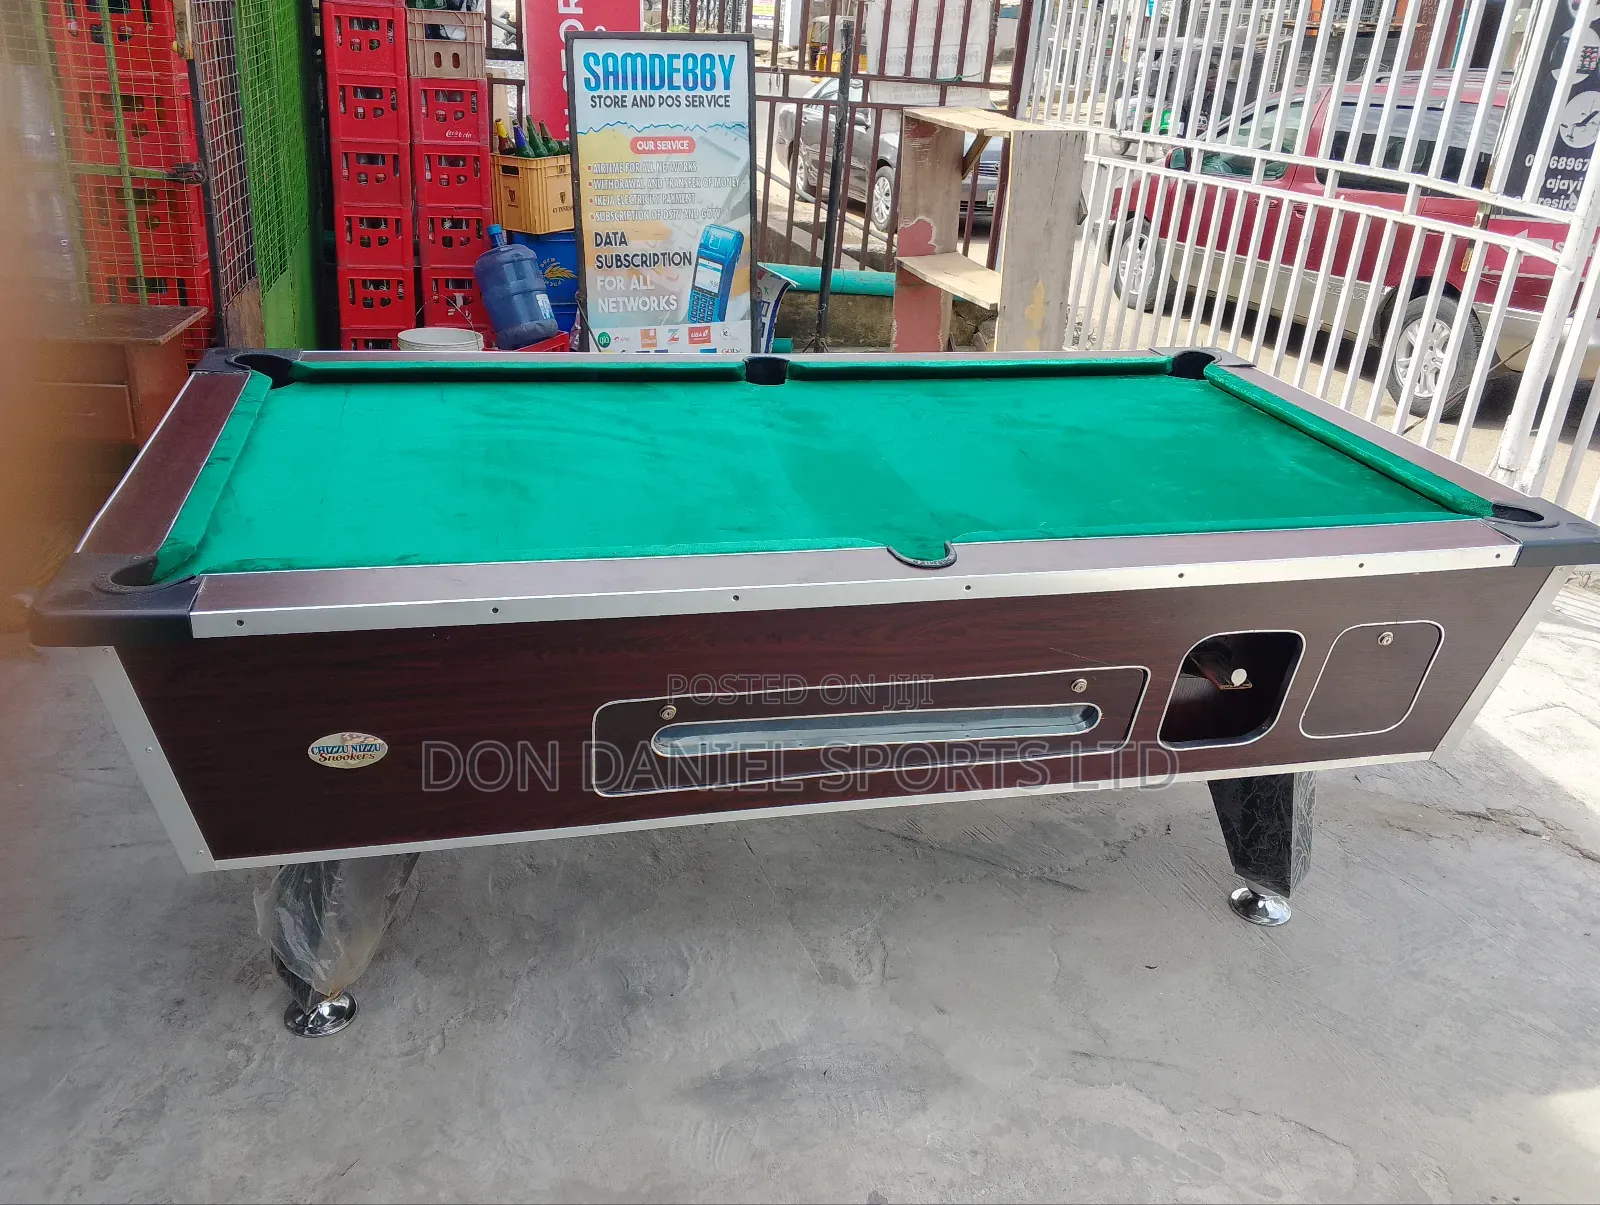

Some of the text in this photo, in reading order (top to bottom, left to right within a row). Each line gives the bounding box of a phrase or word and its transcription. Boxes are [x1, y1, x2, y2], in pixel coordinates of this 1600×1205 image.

[583, 52, 736, 91] SAMDEBBY
[590, 94, 731, 109] STORE AND POS SERVICE
[636, 140, 690, 151] OUR SERVICE
[593, 161, 698, 174] AIRTIME FOR ALL NETWORKS
[593, 176, 740, 190] WITHDRAWAL AND TRANSFER OF MONEY
[594, 193, 696, 206] IKEJA ELECTRICITY PAYMENT
[595, 210, 650, 222] SUBSCRIPTION
[651, 209, 661, 221] OF
[663, 209, 682, 220] DSTV
[683, 208, 699, 220] AND
[594, 231, 628, 248] DATA
[595, 251, 693, 270] SUBSCRIPTION
[596, 274, 656, 292] FOR ALL
[597, 295, 678, 313] NETWORKS
[318, 752, 375, 762] Snookers
